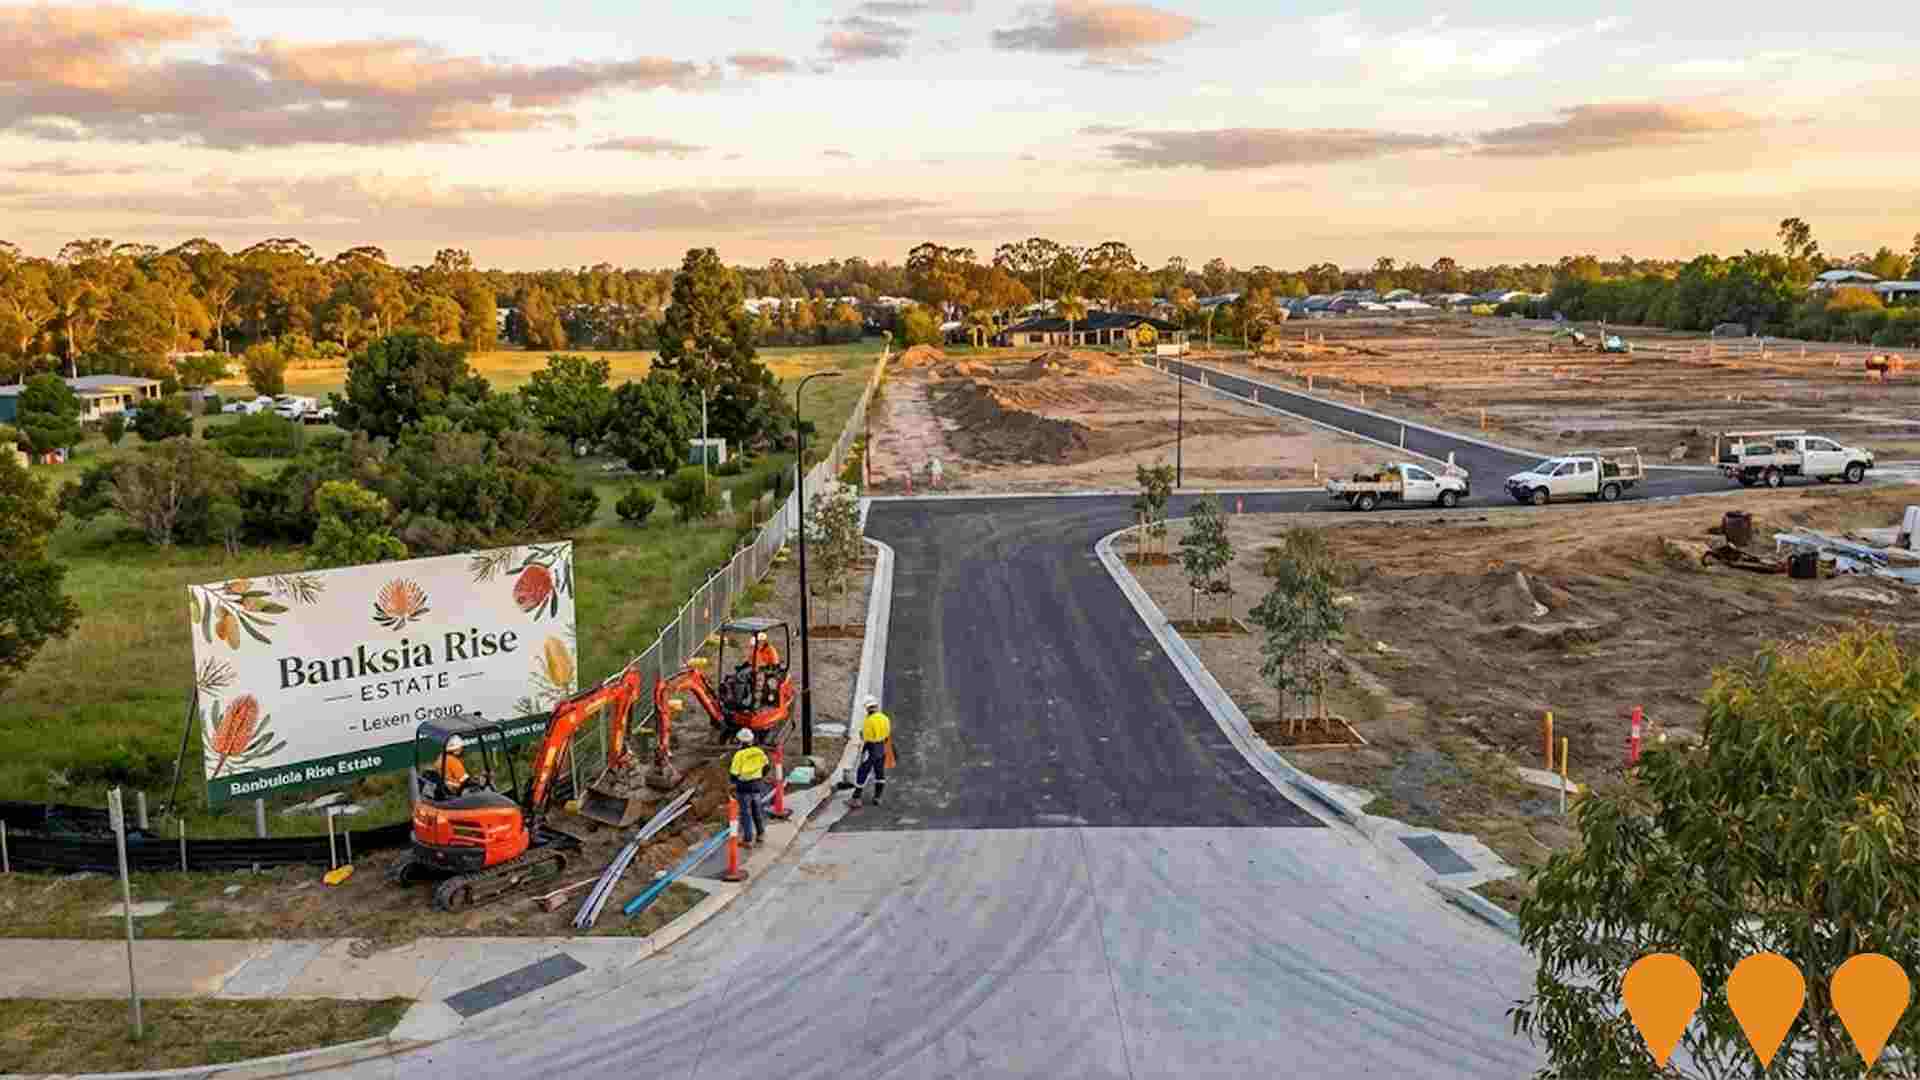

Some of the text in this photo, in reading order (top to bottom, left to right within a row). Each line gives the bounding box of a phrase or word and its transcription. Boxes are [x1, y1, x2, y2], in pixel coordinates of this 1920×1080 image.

[278, 627, 518, 689] Banksia Rise
[360, 671, 449, 702] ESTATE
[362, 703, 463, 733] Lexen Group
[306, 765, 335, 781] Rise
[338, 754, 383, 774] Estate
